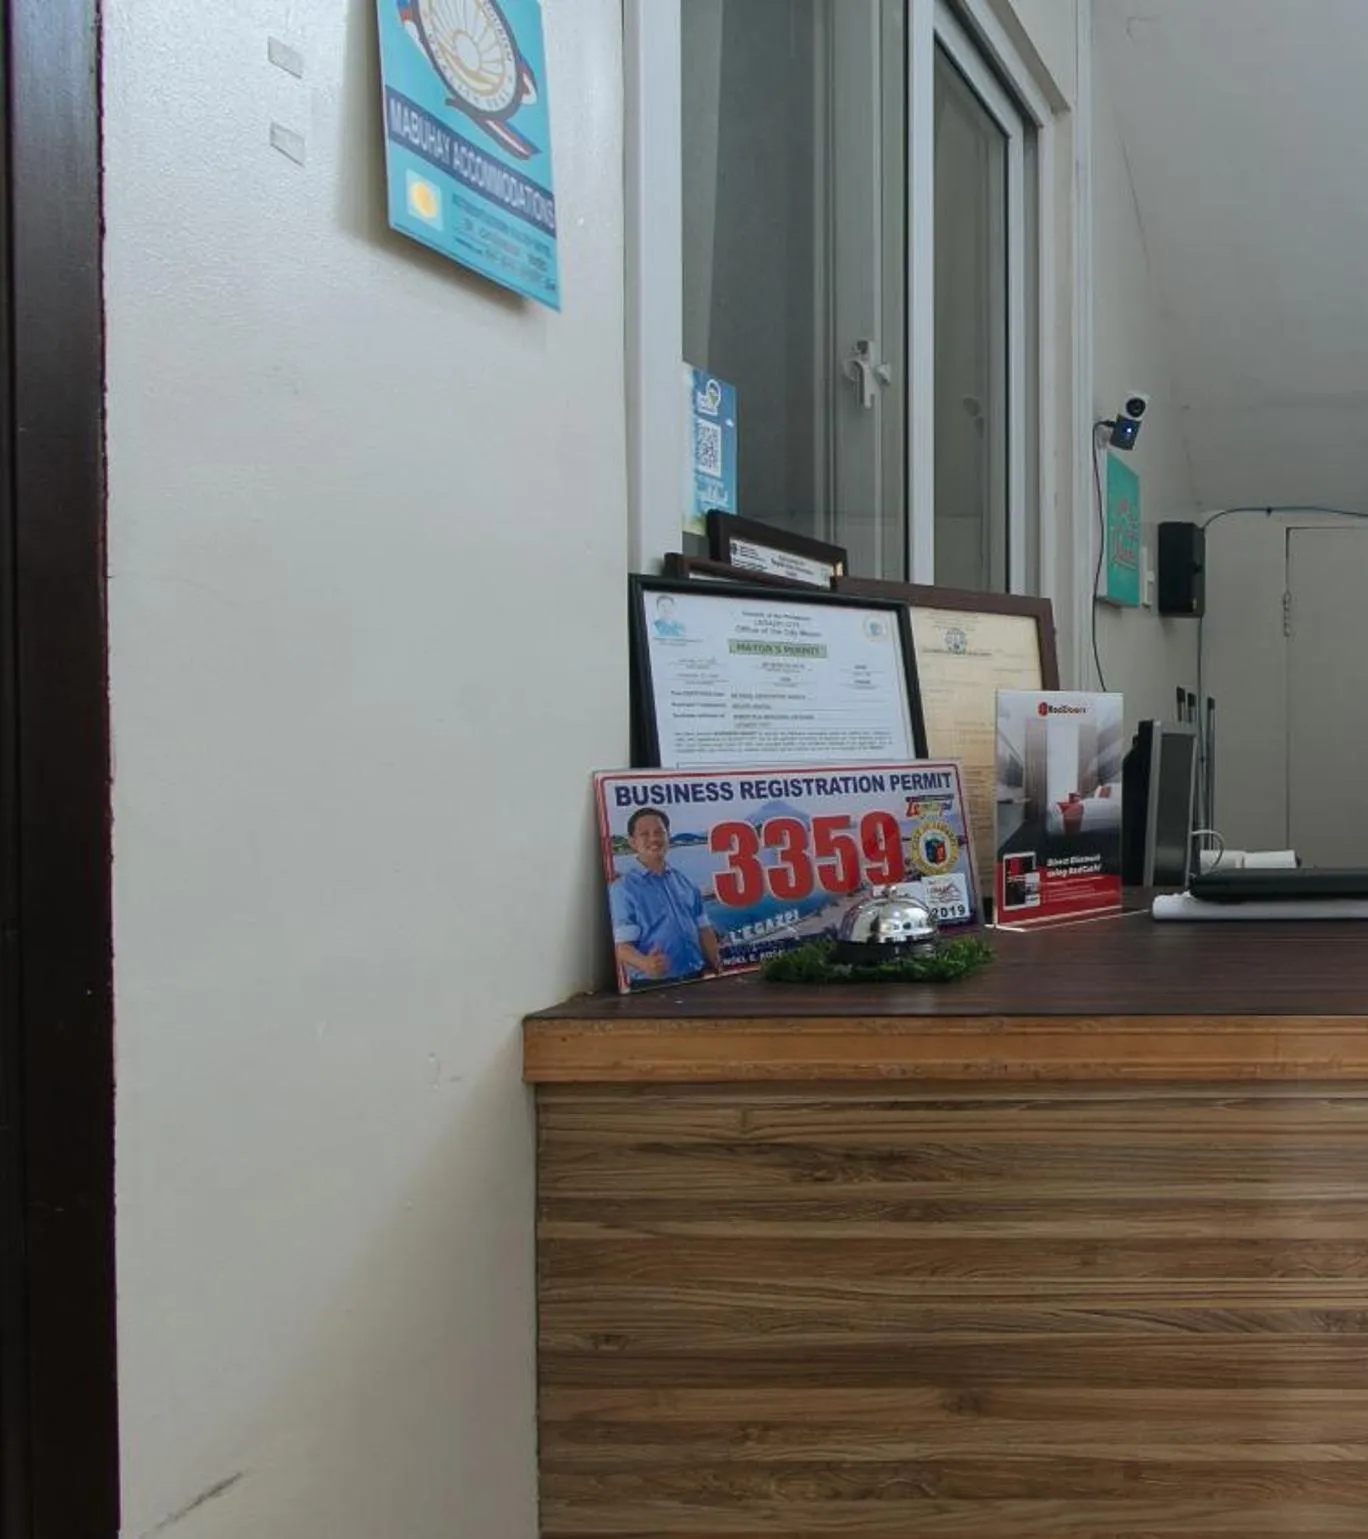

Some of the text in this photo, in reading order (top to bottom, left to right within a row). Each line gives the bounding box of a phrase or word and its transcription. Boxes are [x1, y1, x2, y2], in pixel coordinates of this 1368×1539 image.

[389, 99, 450, 165] MABUHAY
[614, 772, 952, 806] BUSINESS REGISTRATION PERMIT
[708, 811, 904, 908] 3359
[931, 904, 966, 919] 2019
